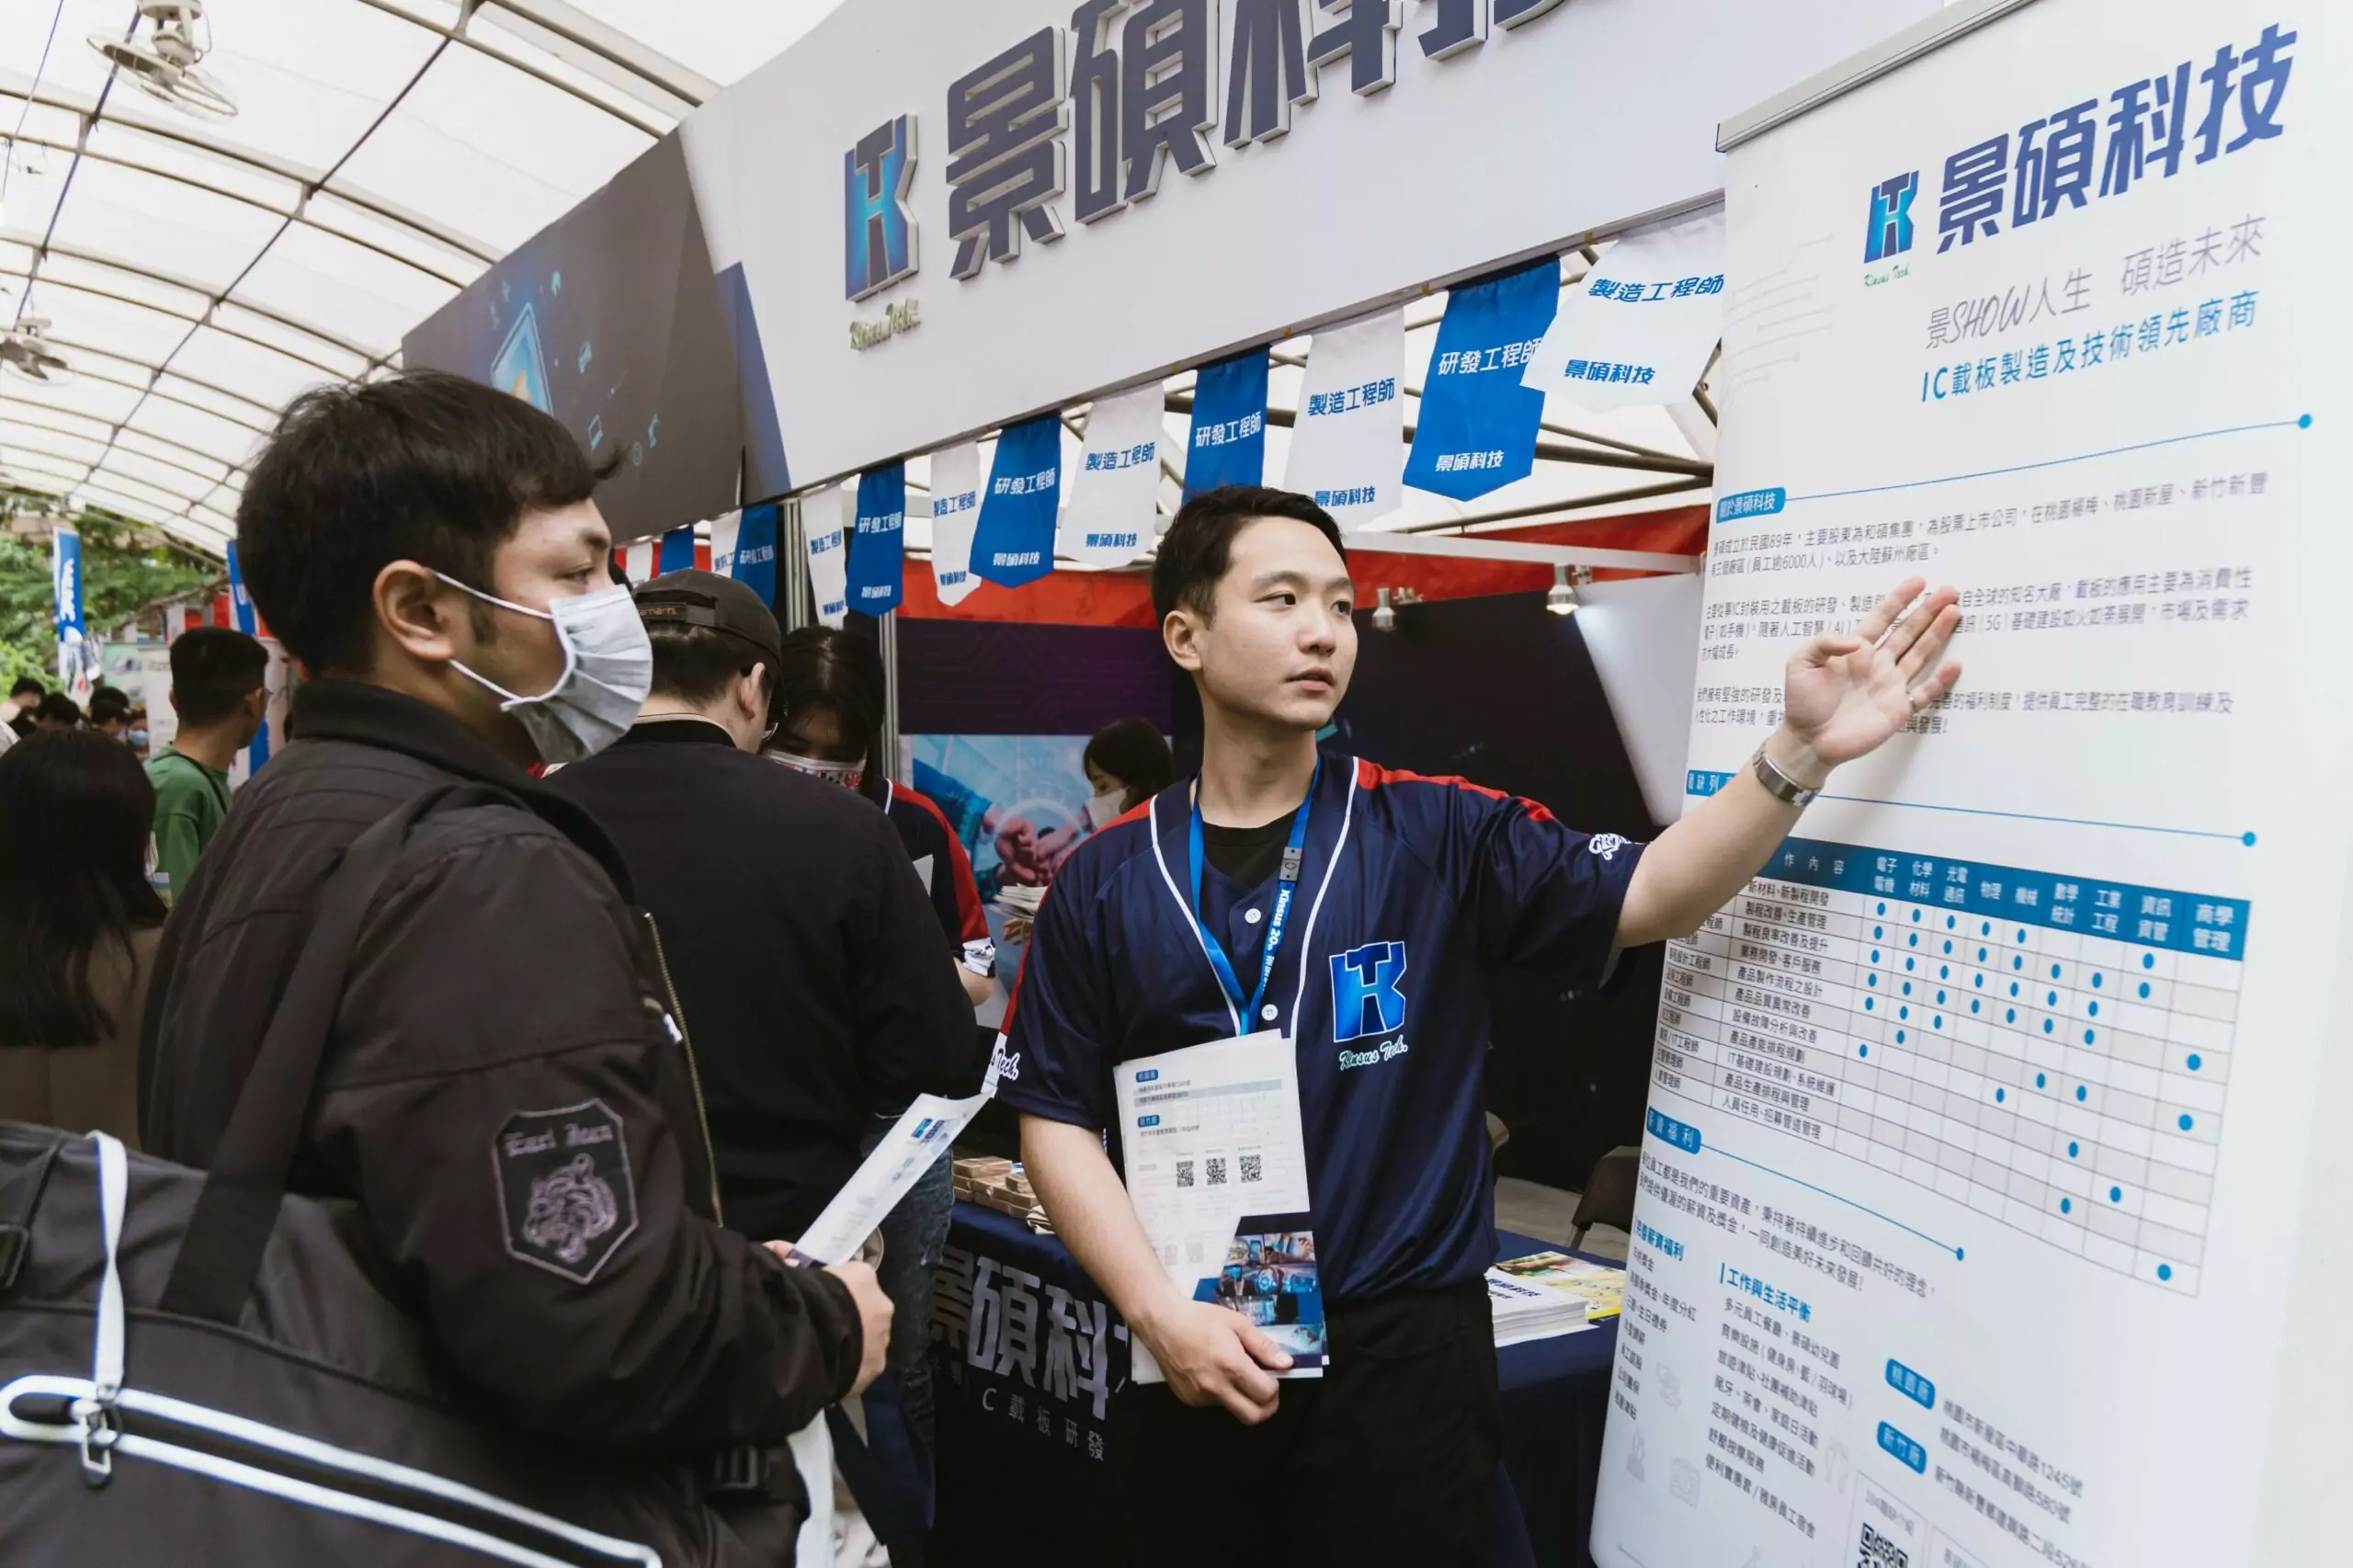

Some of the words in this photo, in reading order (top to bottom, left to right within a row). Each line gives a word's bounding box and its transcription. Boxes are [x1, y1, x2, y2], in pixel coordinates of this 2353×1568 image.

[945, 0, 1567, 282] 景碩科
[1937, 23, 2297, 256] 景碩科技
[1587, 273, 1724, 303] 製造工程師
[1926, 268, 2092, 350] 景SHOW人生
[2120, 212, 2266, 297] 碩造未來
[1438, 336, 1543, 376] 研發工程師
[1922, 290, 2260, 403] IC載板製造及技術領先廠商
[1563, 358, 1655, 385] 景碩科技
[1307, 377, 1395, 417] 製造工程師
[1195, 411, 1262, 449] 研發工程師
[1086, 441, 1155, 471] 製造工程師
[1436, 449, 1505, 472] 景碩科技
[994, 467, 1055, 495] 研發工程師
[1313, 485, 1376, 508] 景碩科技
[993, 551, 1040, 567] 景碩科技
[1086, 533, 1137, 548] 景碩科技
[1688, 771, 1734, 793] 職缺列
[1273, 889, 1290, 927] Kinsus
[1727, 1267, 1812, 1323] 工作與生活平衡
[930, 1244, 1128, 1421] 景碩科
